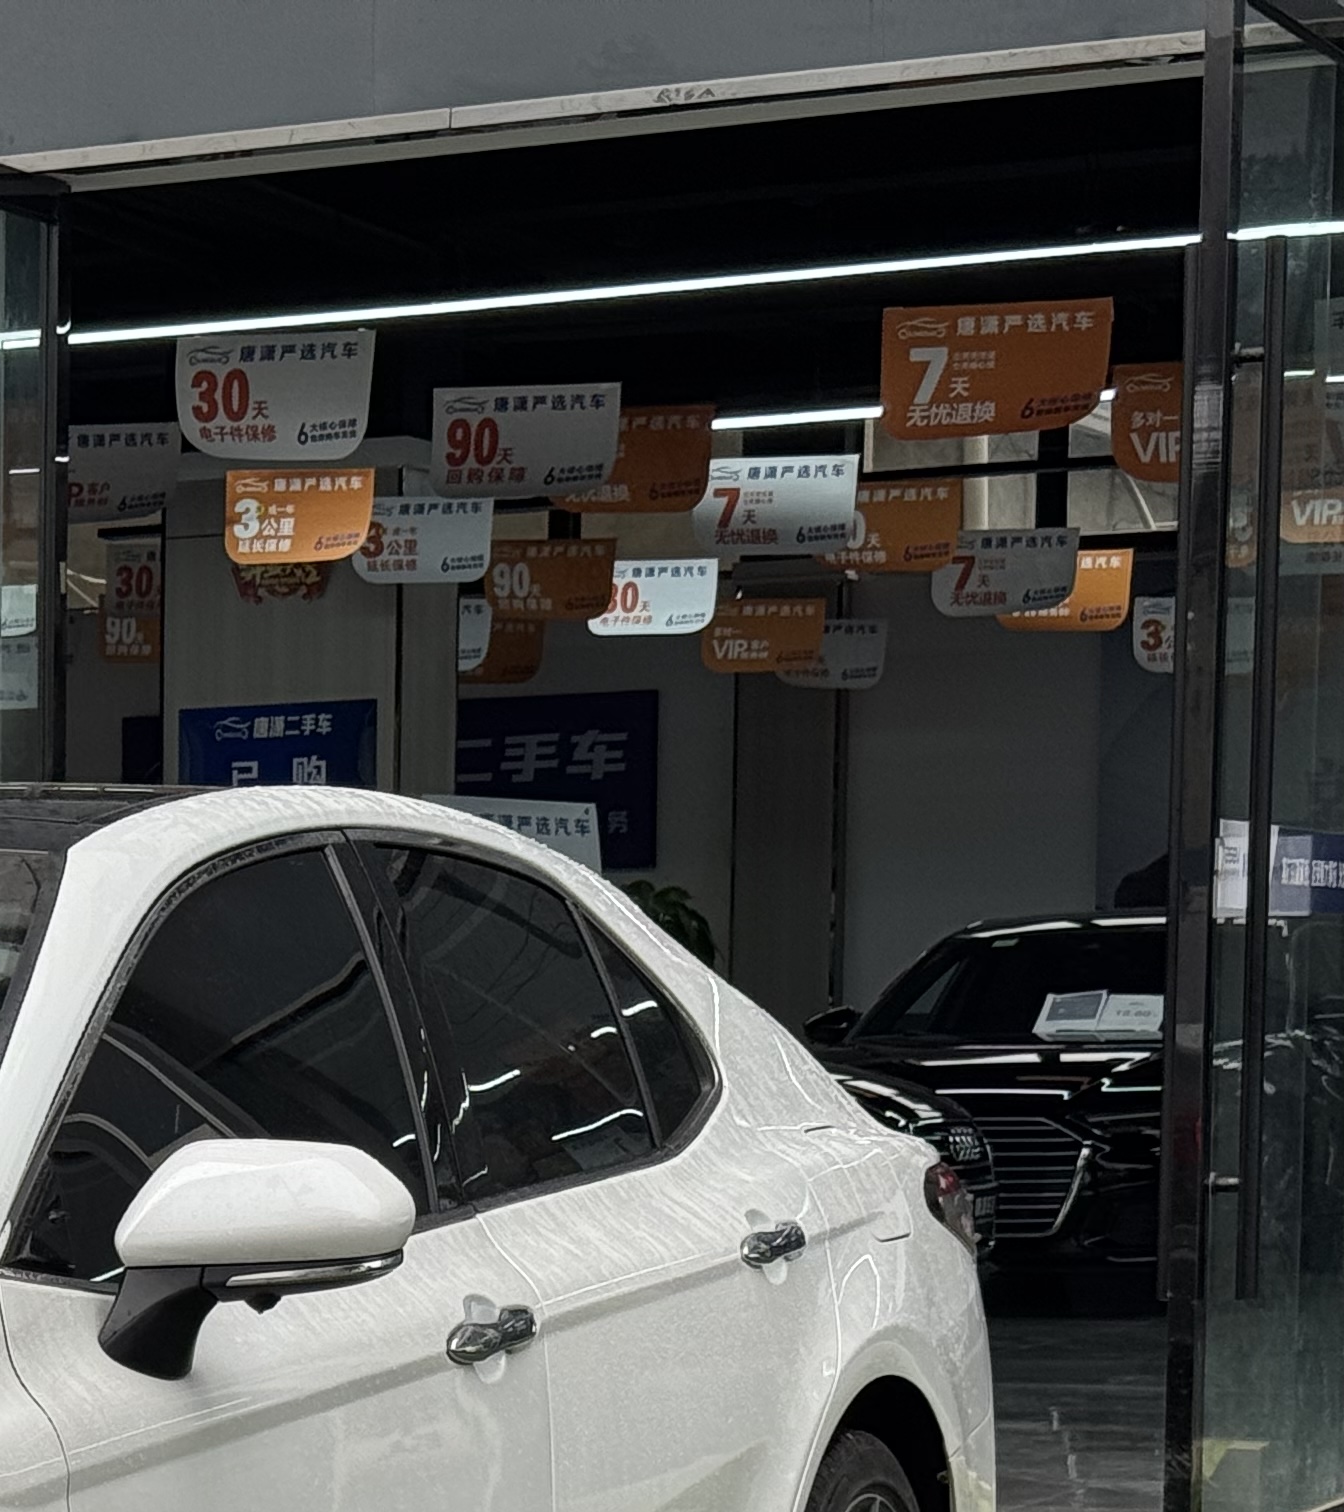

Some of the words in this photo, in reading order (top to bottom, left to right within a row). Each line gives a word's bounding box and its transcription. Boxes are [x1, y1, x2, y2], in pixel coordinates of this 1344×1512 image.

[956, 310, 1095, 336] 唐潇严选汽车
[239, 341, 360, 362] 唐潇严选汽车
[908, 346, 949, 405] 7
[949, 376, 970, 398] 天
[190, 368, 251, 423] 30
[252, 400, 270, 420] 天
[493, 393, 607, 412] 唐潇严选汽车
[906, 402, 997, 426] 无忧退换
[1020, 398, 1034, 419] 6
[1131, 408, 1179, 430] 多对一
[198, 425, 278, 443] 电子件保修
[297, 421, 309, 446] 6
[446, 417, 500, 469] 90
[498, 447, 515, 466] 天
[445, 466, 529, 485] 回购保障
[543, 467, 555, 485] 6
[746, 464, 846, 480] 唐潇严选汽车
[274, 477, 364, 493] 唐潇严选汽车
[233, 497, 261, 539] 3
[398, 502, 483, 516] 唐潇严选汽车
[713, 487, 741, 530] 7
[742, 508, 757, 525] 天
[1291, 497, 1342, 526] VIP
[261, 517, 296, 537] 公里
[715, 528, 779, 545] 无忧退换
[796, 526, 806, 544] 6
[358, 520, 385, 559] 3
[386, 539, 418, 557] 公里
[866, 532, 881, 549] 天
[980, 535, 1069, 549] 唐潇严选汽车
[366, 559, 418, 572] 延长保修
[951, 555, 976, 593] 7
[977, 575, 990, 588] 天
[115, 564, 154, 600] 30
[492, 561, 531, 599] 90
[105, 615, 137, 646] 90
[1140, 618, 1167, 652] 3
[712, 639, 749, 661] VIP
[456, 728, 629, 783] 二手车
